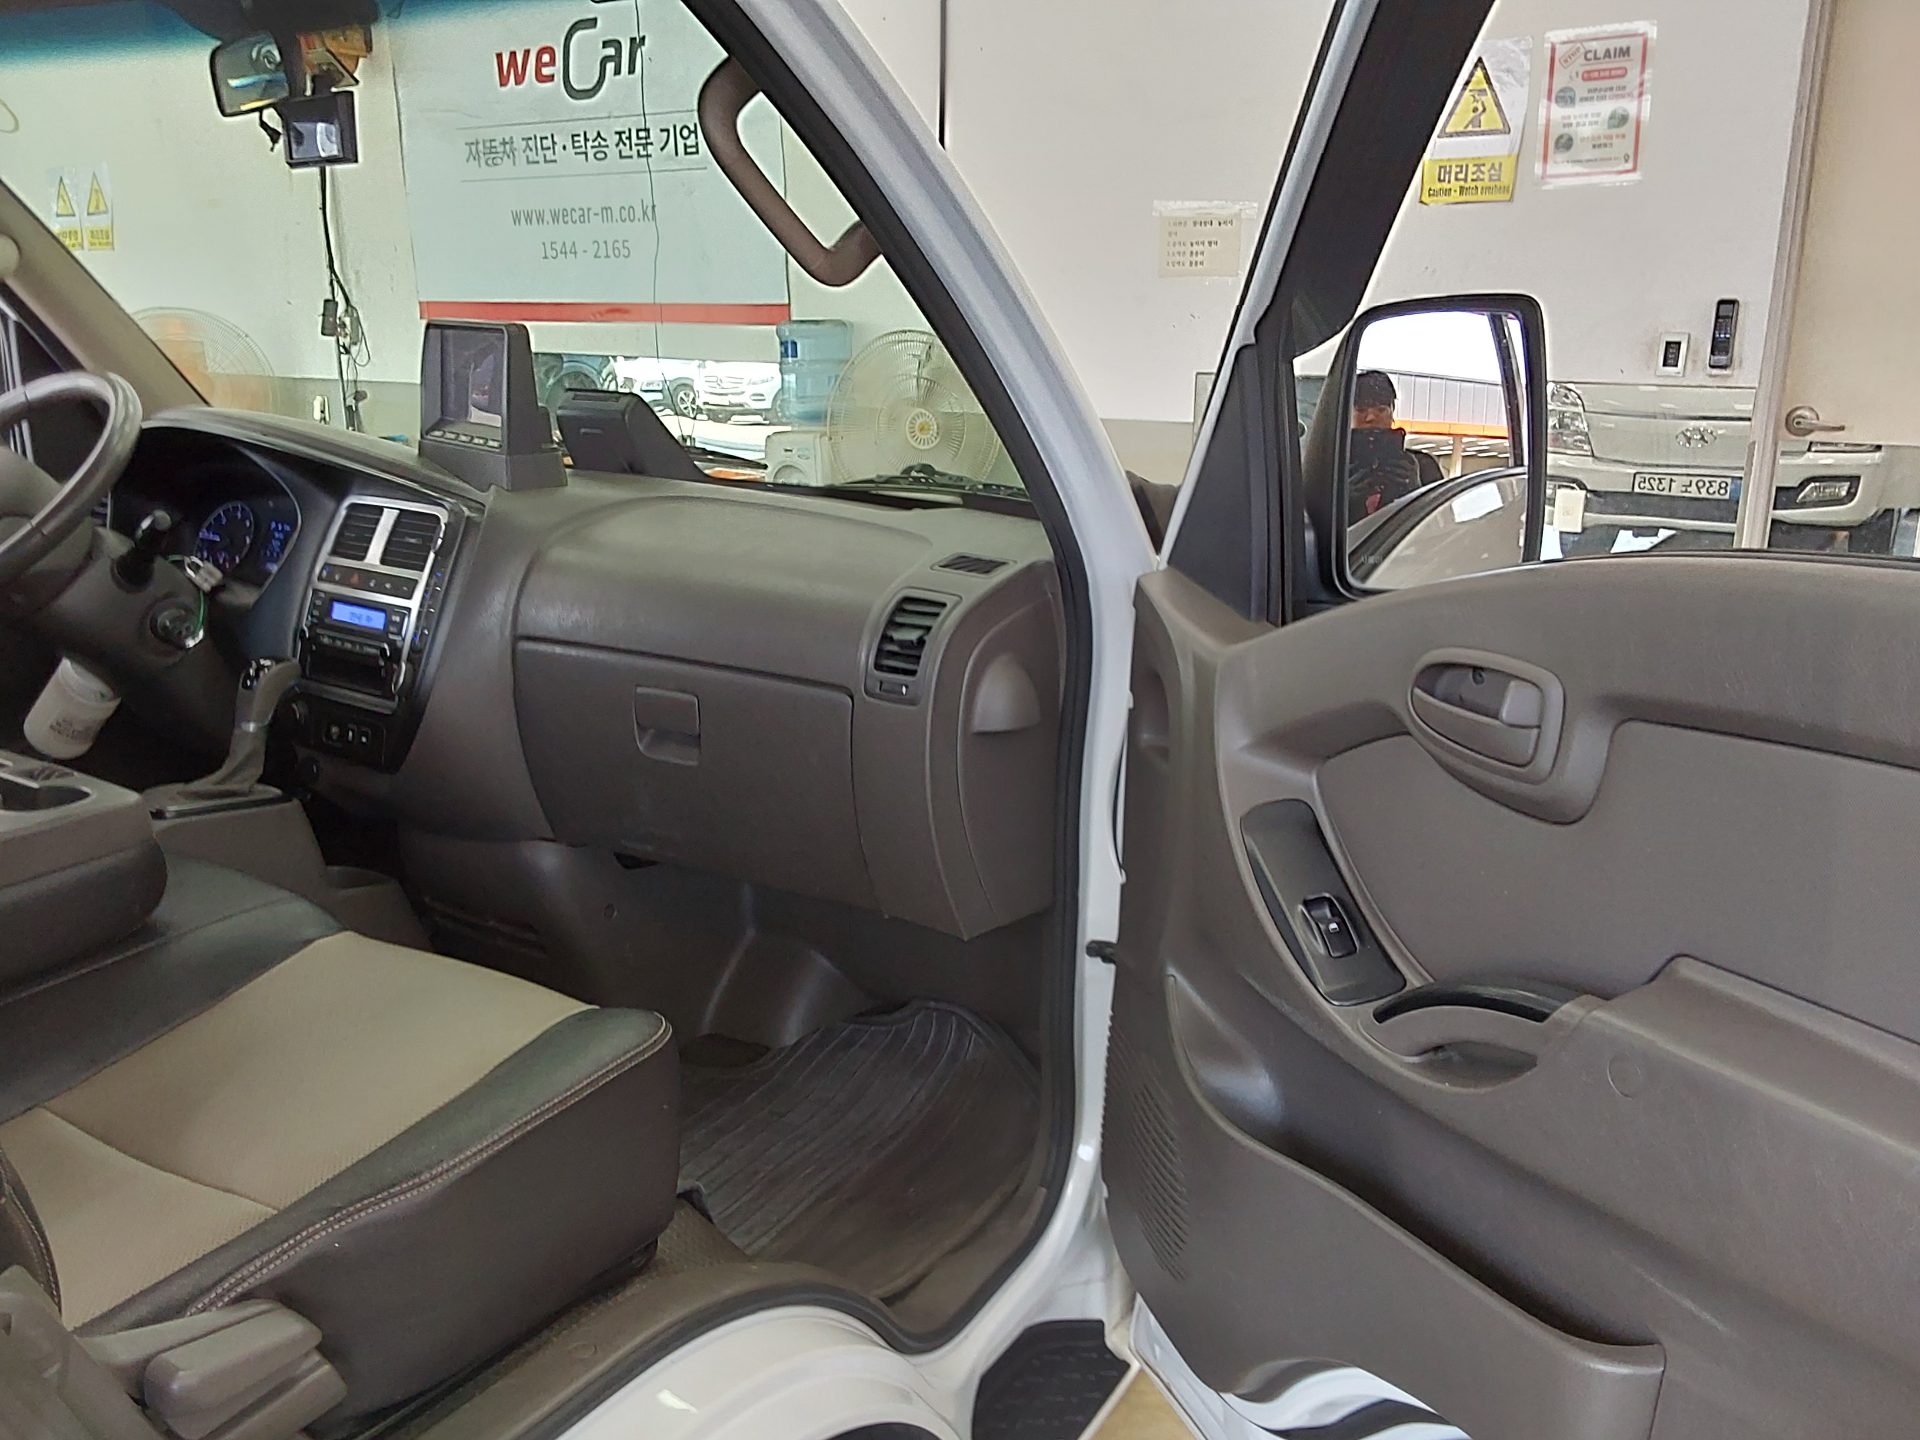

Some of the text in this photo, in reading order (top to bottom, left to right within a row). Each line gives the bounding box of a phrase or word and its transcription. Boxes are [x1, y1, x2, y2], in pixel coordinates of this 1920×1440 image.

[1583, 46, 1631, 62] CLAIM
[614, 127, 654, 160] 전문
[660, 122, 700, 158] 기업
[1437, 161, 1502, 184] 머리조심
[511, 198, 656, 226] www.wecar-m.co.kr
